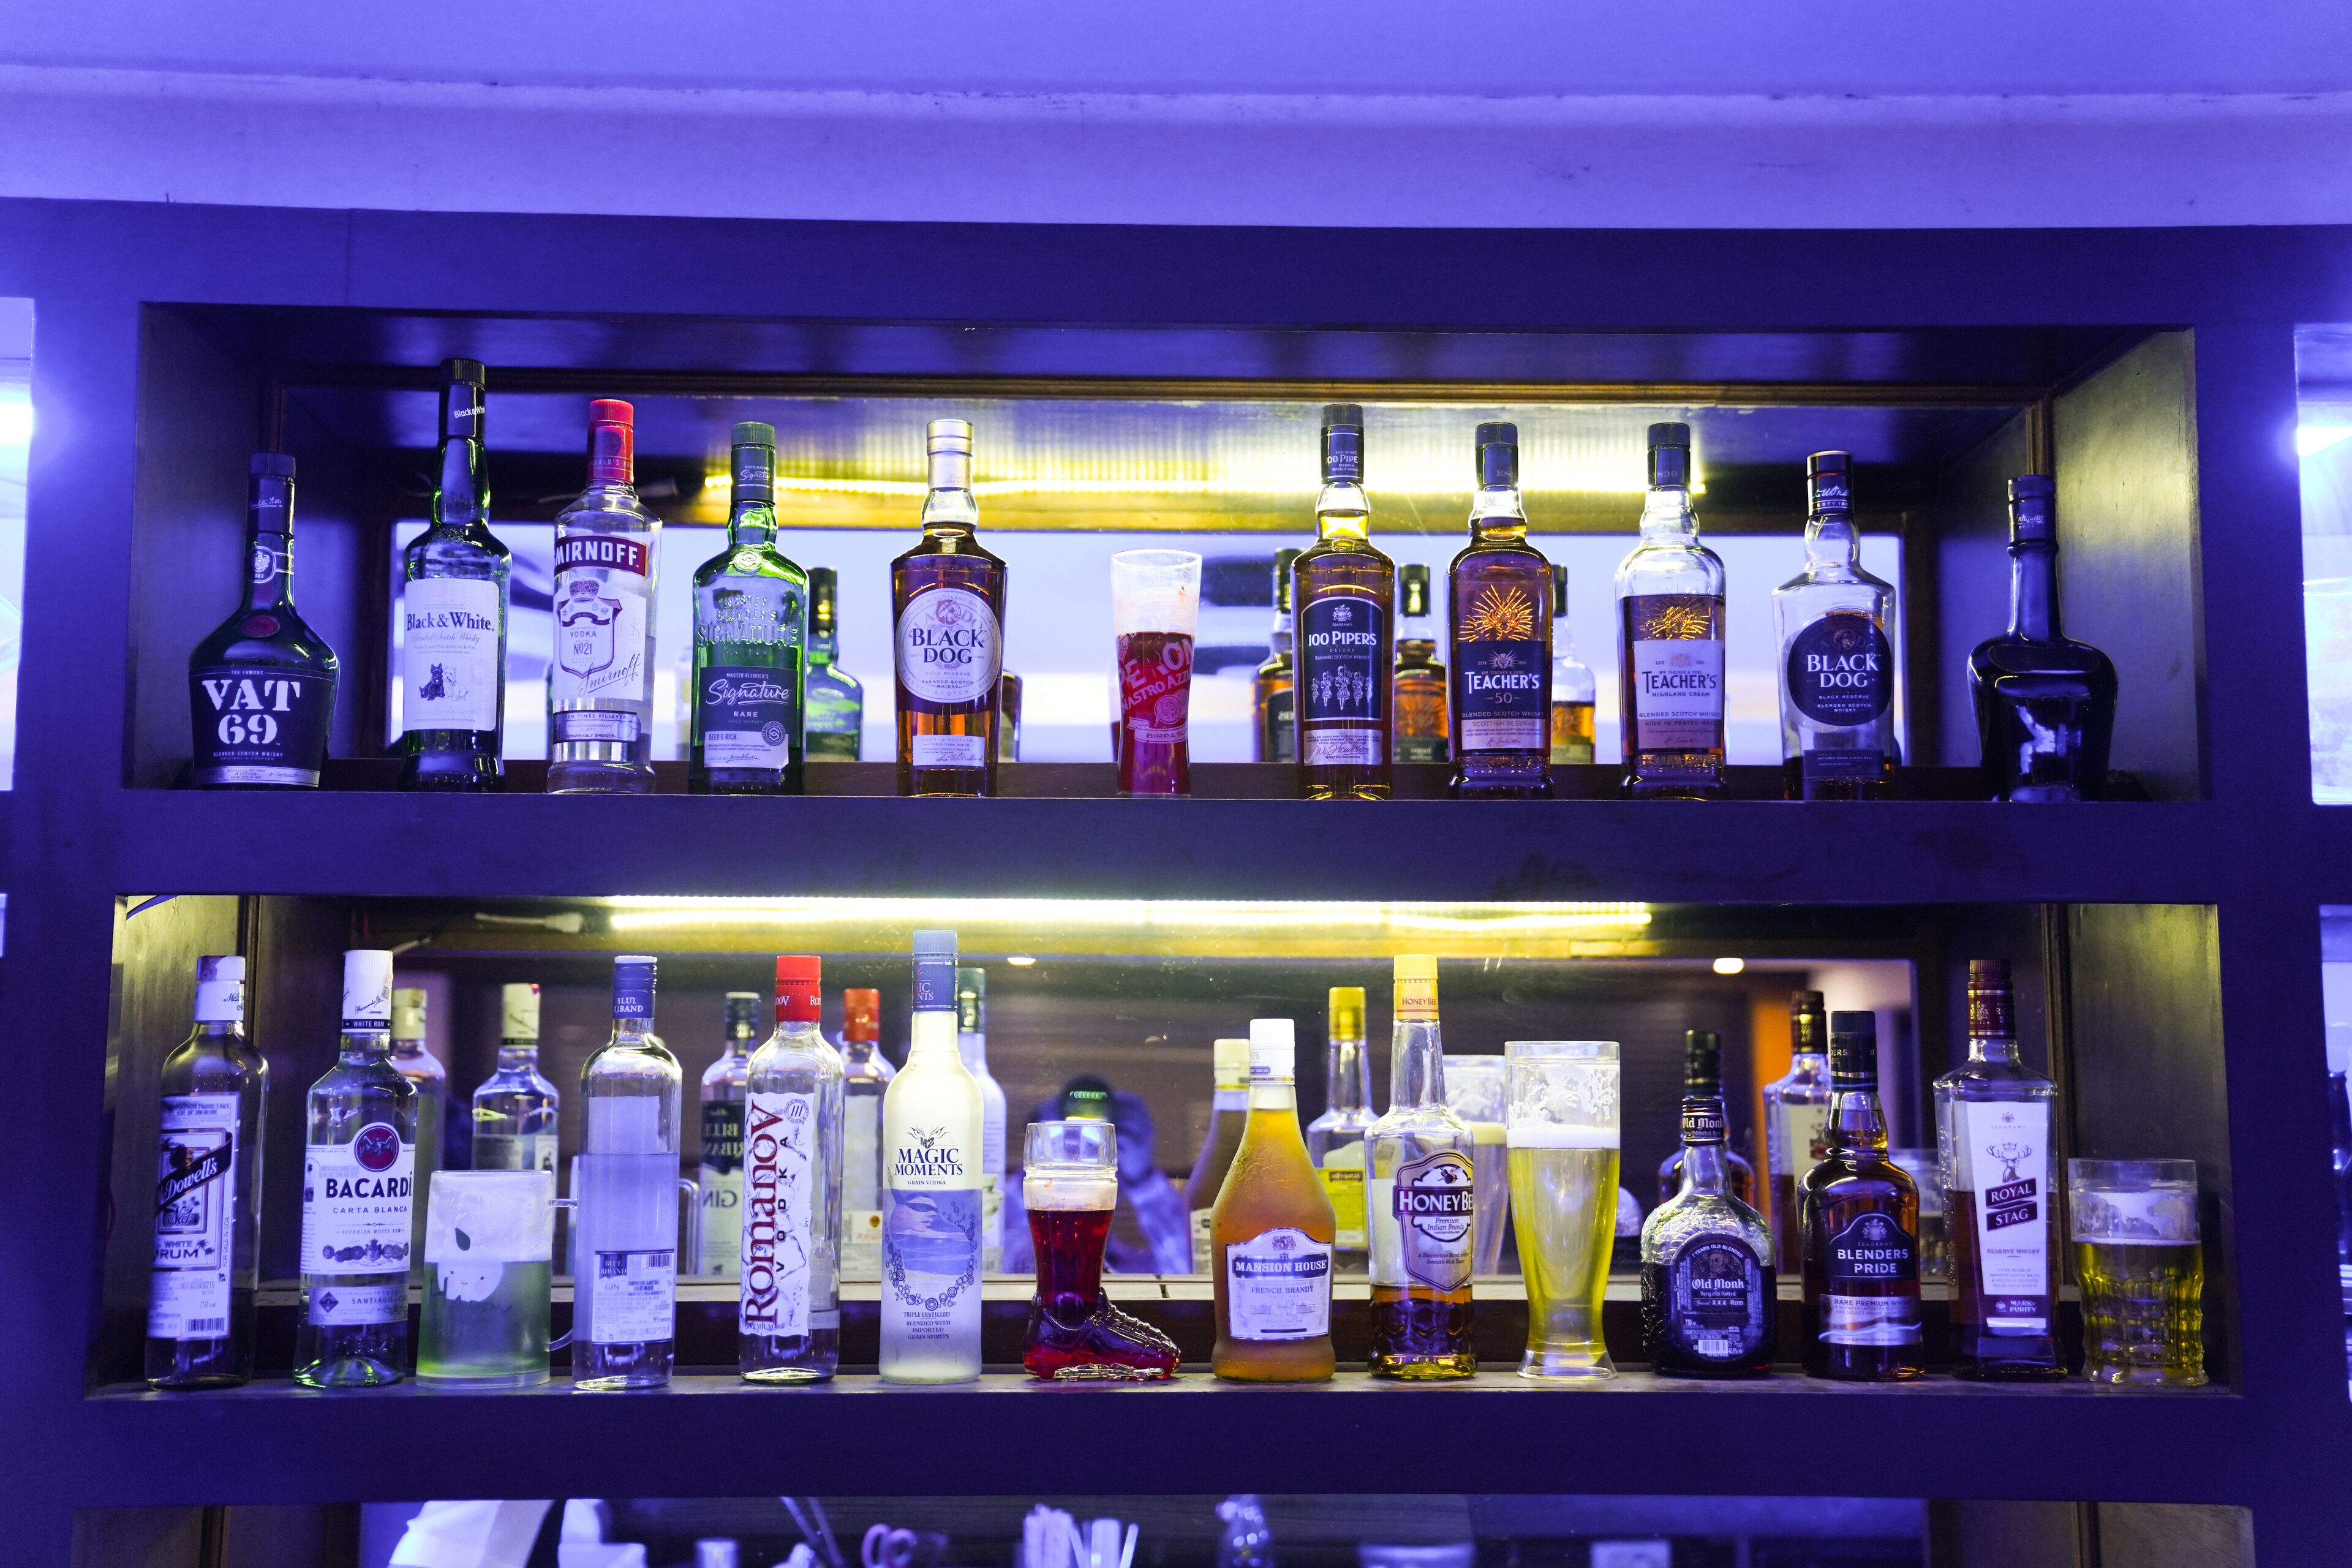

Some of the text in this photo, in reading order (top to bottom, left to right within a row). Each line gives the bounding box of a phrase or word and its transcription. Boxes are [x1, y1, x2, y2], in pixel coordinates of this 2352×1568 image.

[556, 540, 638, 567] MIRNOFF
[407, 611, 491, 631] Black & White
[434, 631, 480, 644] Scotch Whisky
[911, 628, 985, 648] BLACK
[1308, 631, 1377, 646] 100 PIPERS
[924, 647, 973, 664] DOG
[1807, 654, 1879, 673] BLACK
[576, 653, 641, 697] Smirnoff
[1464, 671, 1540, 695] TEACHER'S
[1642, 671, 1717, 694] TEACHER'S
[1819, 673, 1868, 688] DOG
[202, 679, 300, 711] VAT
[706, 679, 789, 705] Signature
[1122, 680, 1166, 714] NASTRO
[1494, 692, 1512, 704] 50
[218, 714, 277, 744] 69
[1683, 1117, 1695, 1128] Old
[899, 1148, 959, 1164] MAGIC
[894, 1164, 963, 1176] MOMENTS
[326, 1170, 412, 1199] BACARDÍ
[1991, 1184, 2032, 1202] ROYAL
[775, 1136, 788, 1272] VODKA
[1399, 1192, 1461, 1212] HONEY
[1996, 1208, 2029, 1226] STAG
[160, 1249, 198, 1259] RUM
[1694, 1245, 1709, 1255] YEARS
[1722, 1245, 1743, 1258] BLENDED
[1838, 1249, 1908, 1259] BLENDERS
[1235, 1259, 1327, 1273] MANSION HOUSE
[1854, 1263, 1897, 1273] PRIDE
[1692, 1279, 1744, 1291] Old Monk
[746, 1322, 774, 1331] PREMIUM
